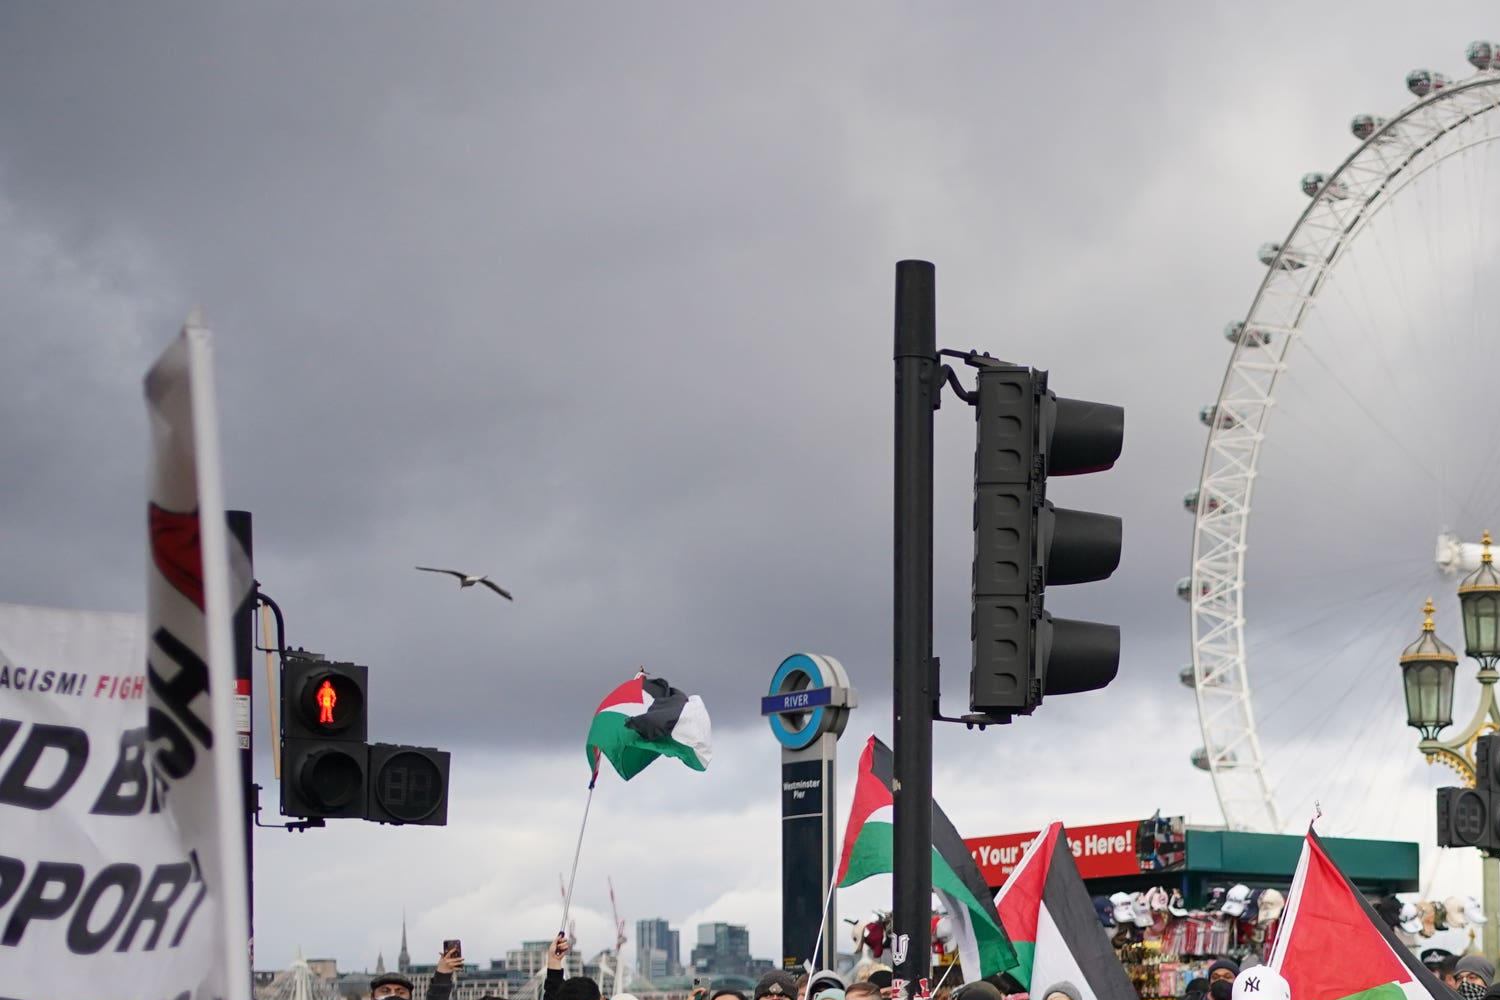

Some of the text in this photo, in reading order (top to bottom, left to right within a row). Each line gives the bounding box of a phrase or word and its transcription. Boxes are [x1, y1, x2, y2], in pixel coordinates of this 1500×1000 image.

[784, 693, 809, 709] RIVER
[783, 778, 821, 792] Westminster
[793, 789, 805, 800] Pier
[978, 845, 1019, 867] Your
[1084, 829, 1133, 857] Here!
